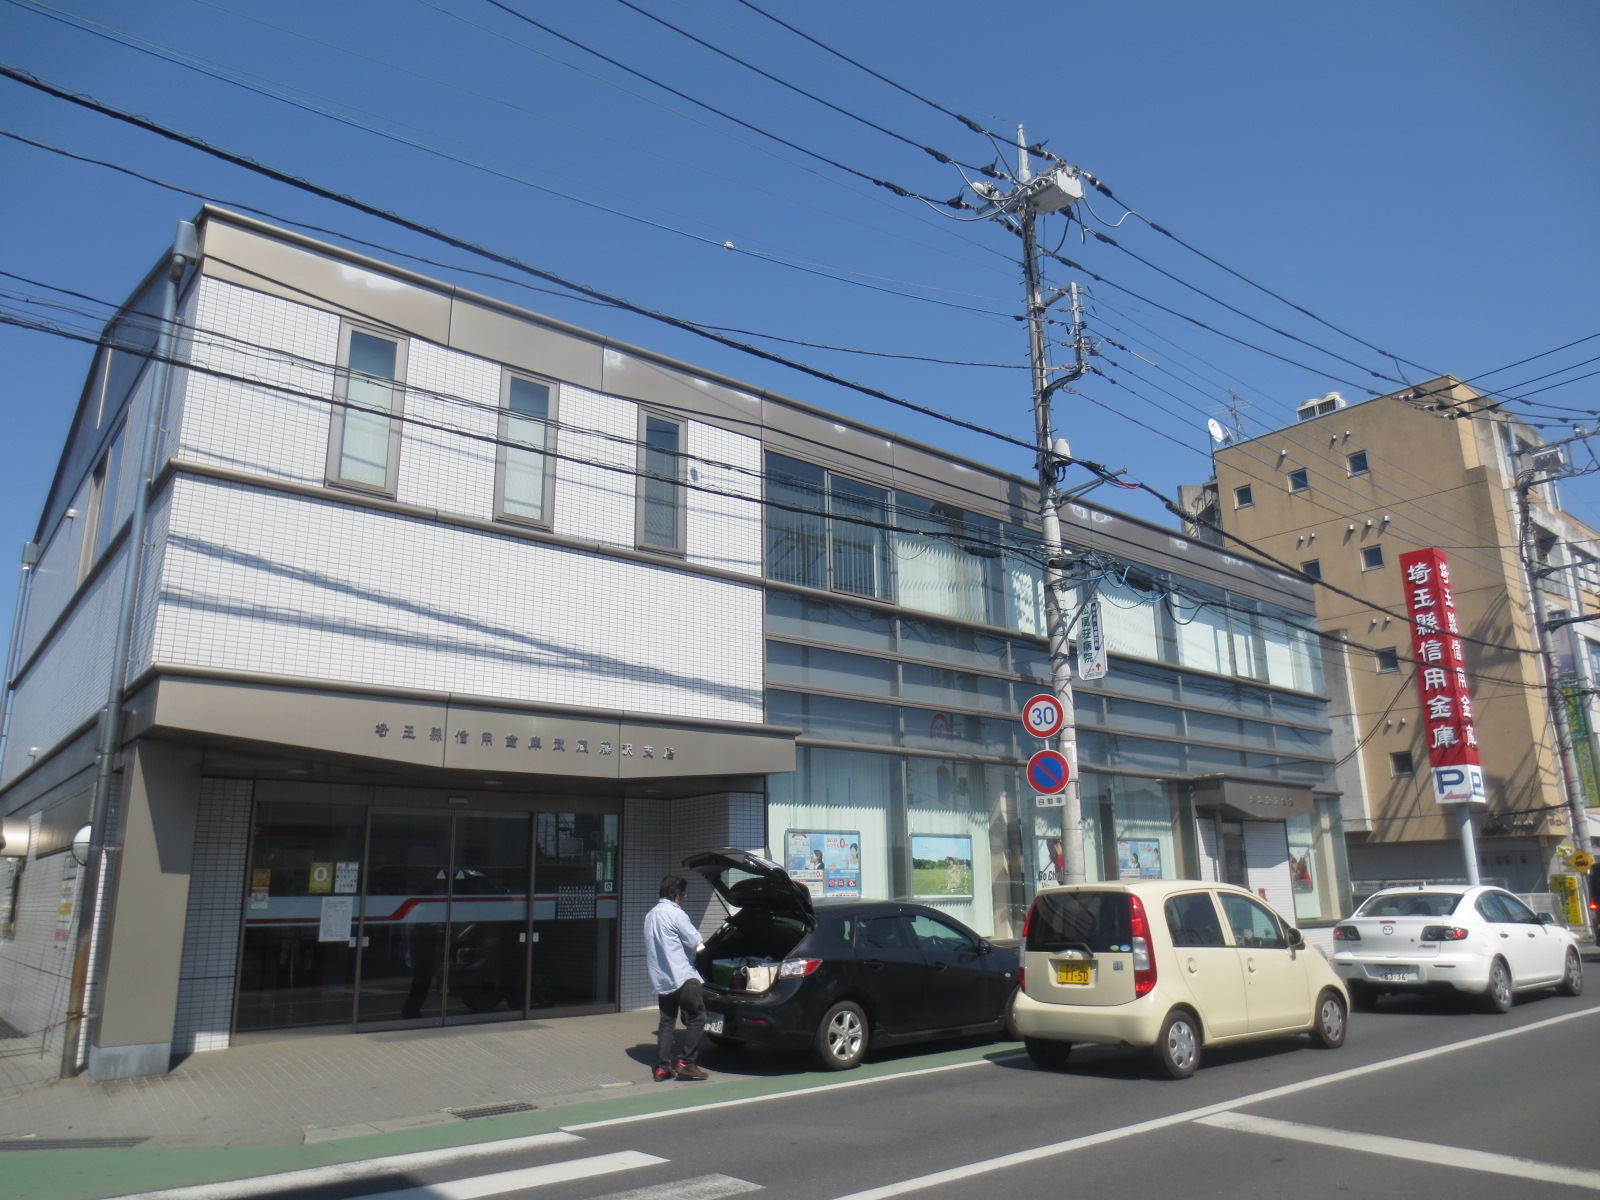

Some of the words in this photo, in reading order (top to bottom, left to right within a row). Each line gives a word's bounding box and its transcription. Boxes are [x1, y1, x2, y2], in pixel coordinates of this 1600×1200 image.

[1407, 561, 1459, 749] 埼玉縣信用金庫
[1032, 706, 1055, 726] 30
[1436, 770, 1465, 795] P
[1471, 771, 1485, 796] P
[1038, 796, 1063, 806] 自動車
